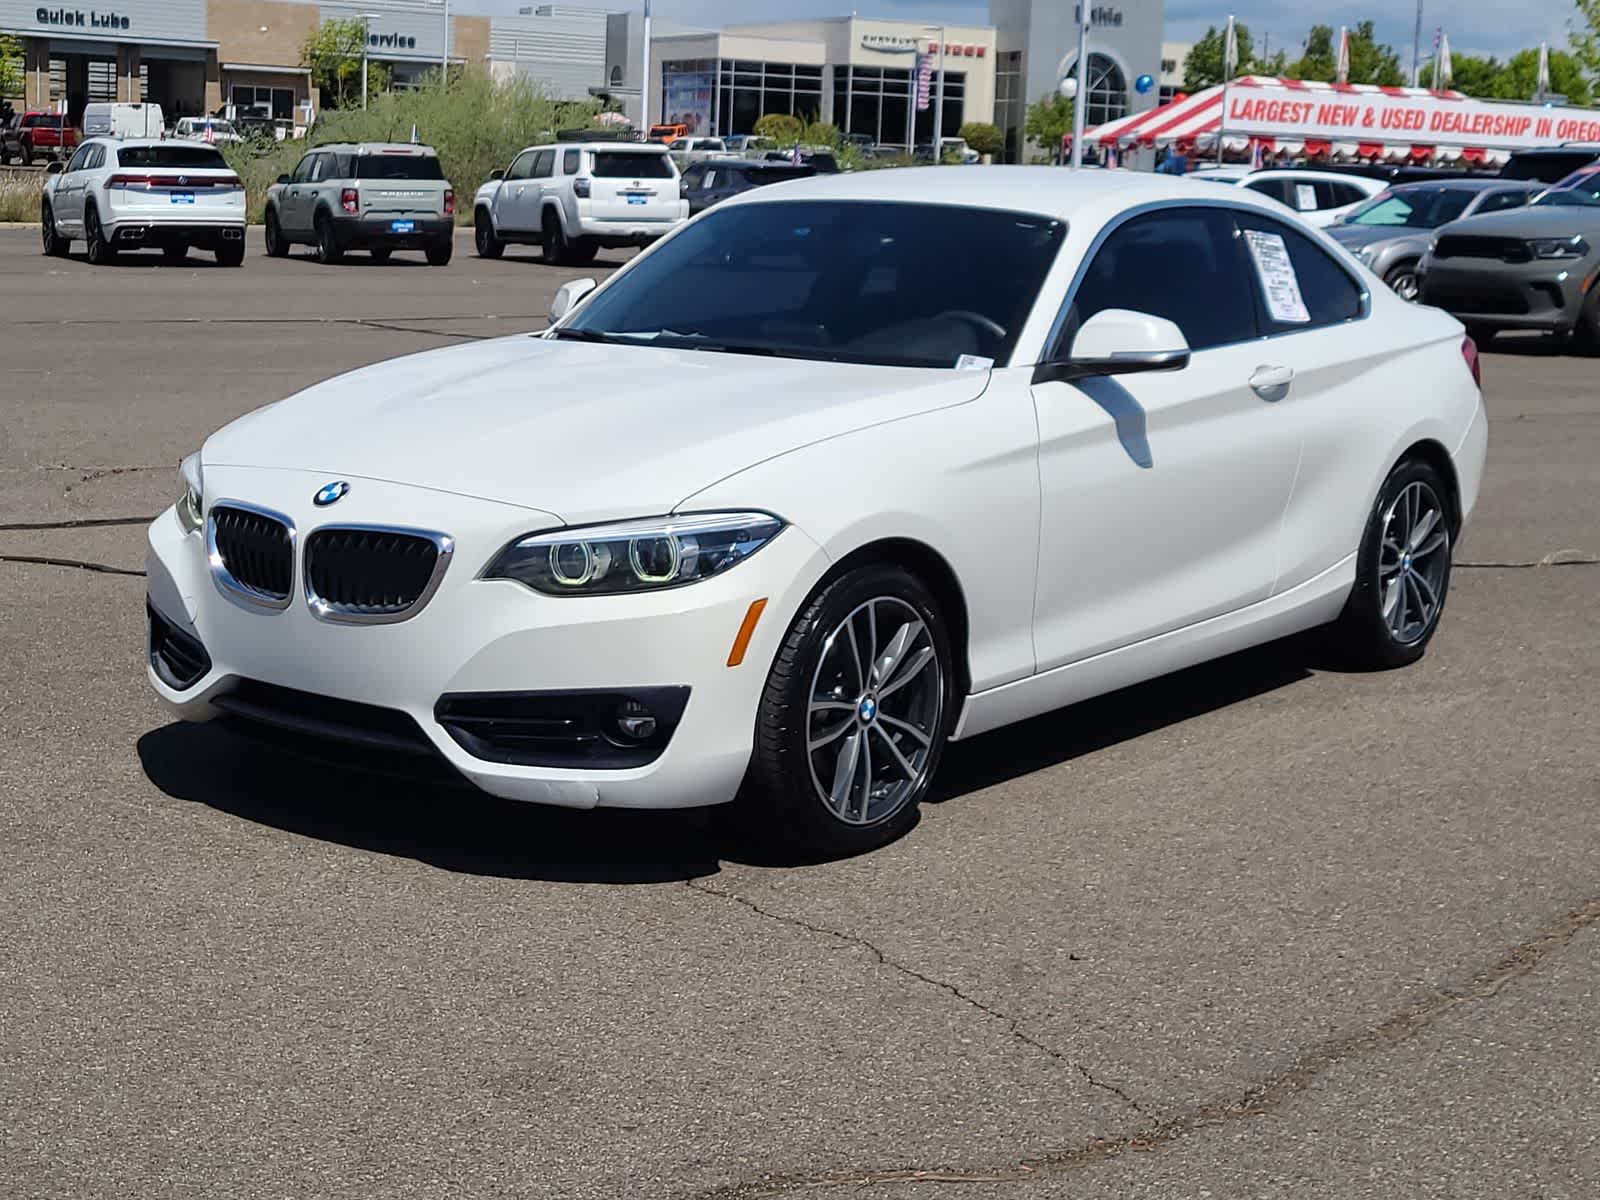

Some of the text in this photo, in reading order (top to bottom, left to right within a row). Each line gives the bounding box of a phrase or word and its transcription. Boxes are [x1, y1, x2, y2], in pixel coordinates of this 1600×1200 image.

[36, 7, 130, 29] Quick Lube
[1230, 98, 1600, 142] LARGEST NEW & USED DEALERSHIP IN OREG
